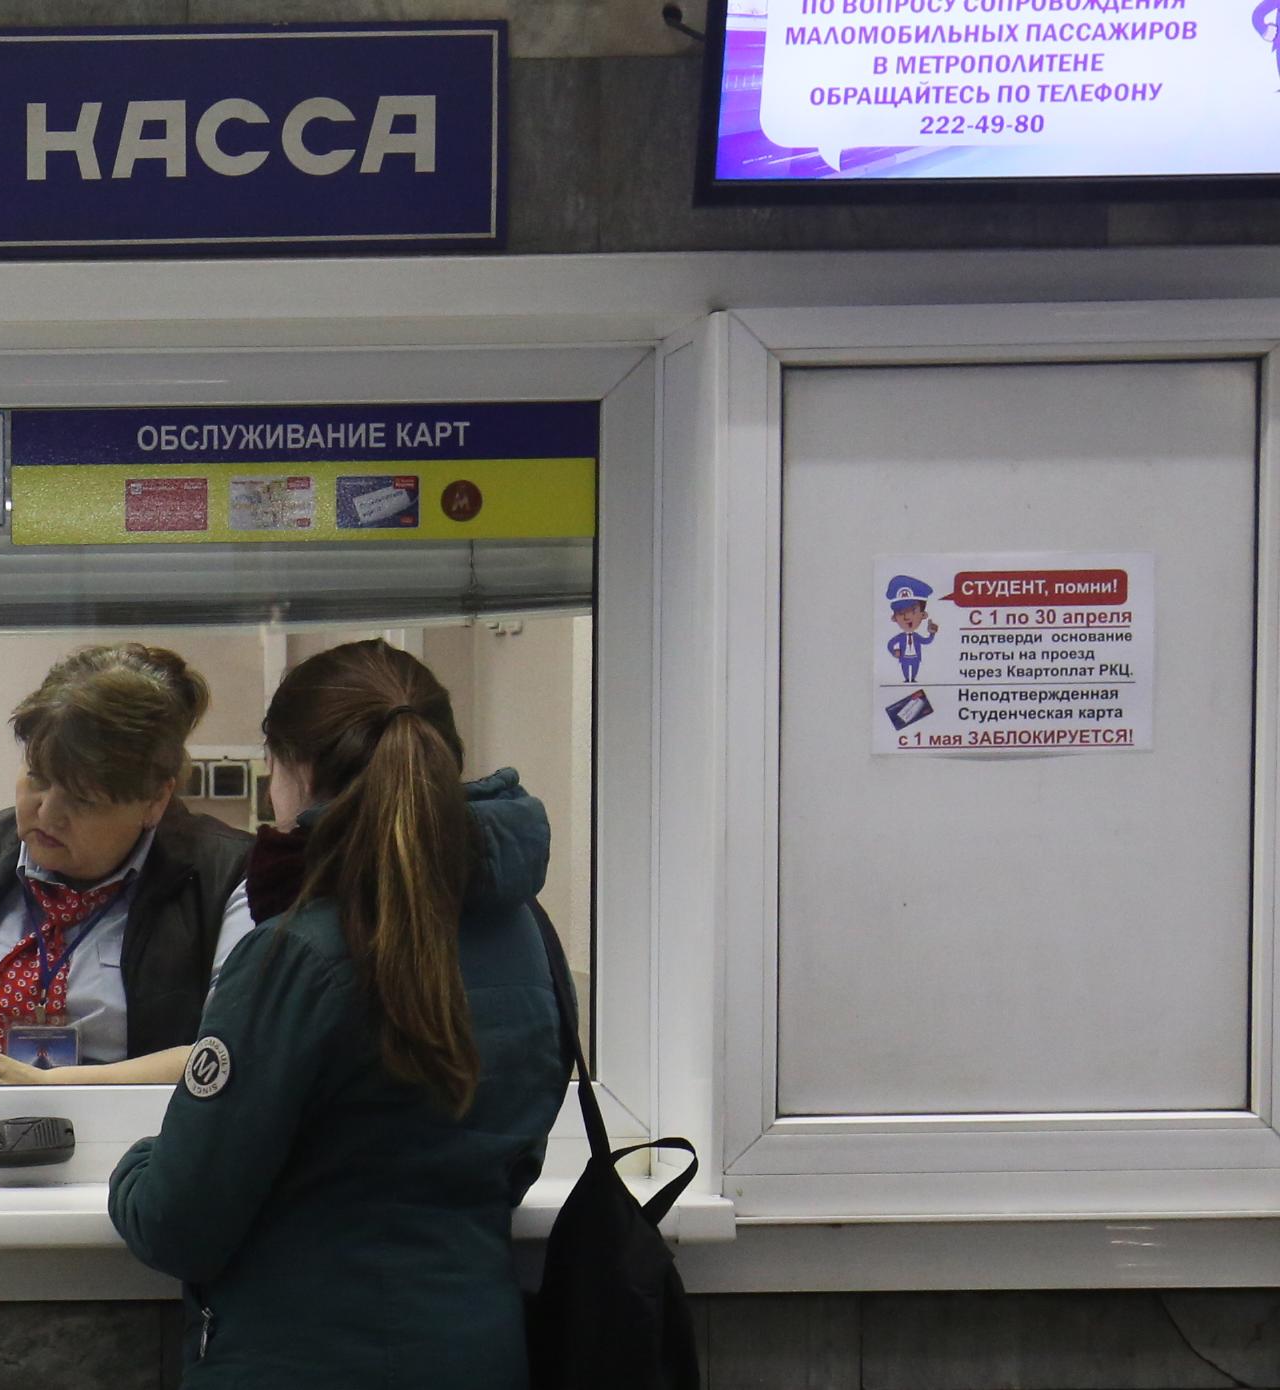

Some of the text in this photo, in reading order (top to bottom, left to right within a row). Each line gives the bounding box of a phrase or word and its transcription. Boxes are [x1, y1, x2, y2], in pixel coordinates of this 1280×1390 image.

[802, 0, 1186, 14] ПО ВОПРОСУ СОПРОВОЖДЕНИЯ
[786, 21, 1198, 45] МАЛОМОБИЛЬНЫХ ПАССАЖИРОВ
[873, 53, 1103, 75] В МЕТРОПОЛИТЕНЕ
[810, 81, 1162, 108] ОБРАЩАЙТЕСЬ ПО ТЕЛЕФОНУ
[920, 115, 1045, 135] 222-49-80
[27, 95, 436, 181] КАССА
[137, 421, 471, 452] ОБСЛУЖИВАНИЕ КАРТ
[961, 579, 1117, 597] СТУДЕНТ, помни!
[969, 609, 1132, 627] С 1 по 30 апреля
[961, 631, 1132, 646] подтверди основание
[960, 650, 1095, 663] льготы на проезд
[960, 664, 1134, 680] через Квартоплат РКЦ.
[958, 688, 1119, 704] Неподтвержденная
[958, 707, 1123, 723] Студенческая карта
[898, 729, 1134, 746] с 1 мая ЗАБЛОКИРУЕТСЯ!
